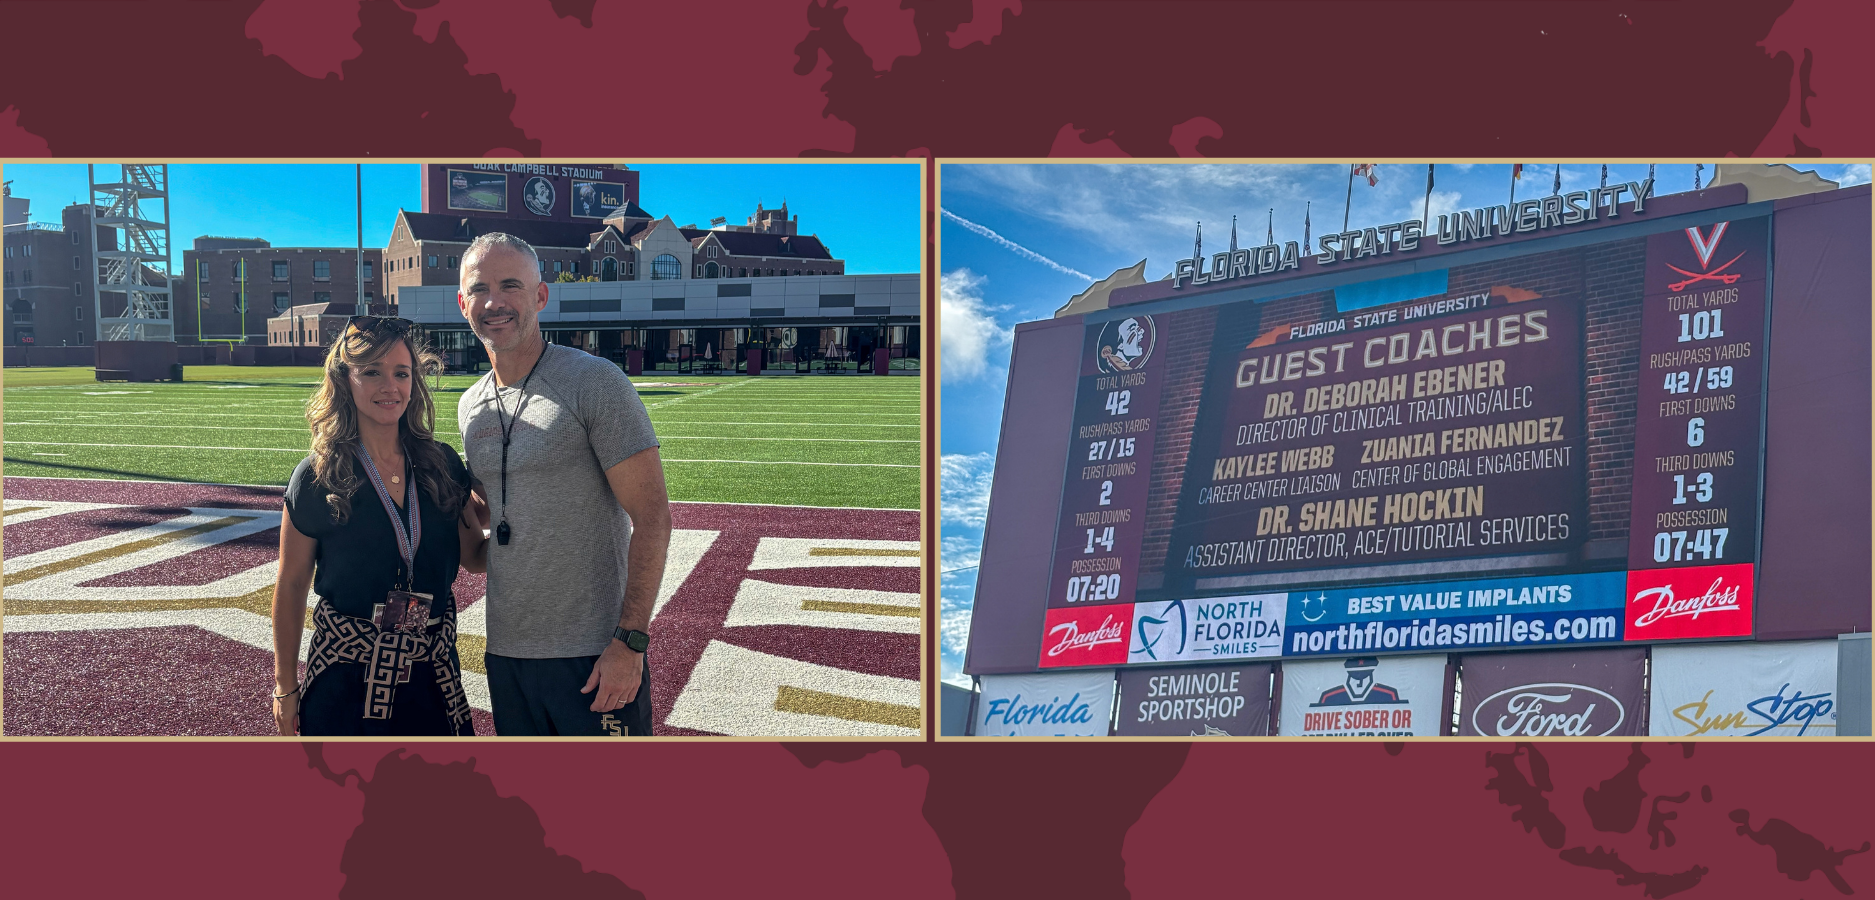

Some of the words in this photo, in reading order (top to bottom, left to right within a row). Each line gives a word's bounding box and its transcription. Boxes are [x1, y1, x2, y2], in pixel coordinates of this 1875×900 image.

[504, 164, 558, 176] CAMPBELL
[562, 166, 603, 180] STADIUM
[1172, 240, 1300, 288] FLORIDA
[1317, 220, 1422, 265] STATE
[1437, 178, 1655, 245] UNIVERSITY
[1668, 294, 1699, 312] TOTAL
[1703, 288, 1738, 306] YARDS
[1290, 318, 1346, 340] FLORIDA
[1354, 310, 1397, 328] STATE
[1404, 292, 1490, 320] UNIVERSITY
[1678, 308, 1724, 342] 101
[1236, 342, 1354, 388] GUEST
[1364, 310, 1549, 368] COACHES
[1650, 347, 1711, 369] RUSH/PASS
[1714, 342, 1750, 361] YARDS
[1096, 376, 1118, 390] TOTAL
[1121, 372, 1146, 388] YARDS
[1264, 390, 1297, 418] DR.
[1303, 374, 1407, 414] DEBORAH
[1413, 359, 1505, 398] EBENER
[1106, 390, 1130, 416] 42
[1236, 416, 1307, 446] DIRECTOR
[1311, 414, 1330, 436] OF
[1332, 404, 1402, 433] CLINICAL
[1408, 386, 1532, 424] TRAINING/ALEC
[1660, 400, 1692, 417] FIRST
[1694, 394, 1736, 414] DOWNS
[1080, 422, 1123, 438] RUSH/PASS
[1125, 418, 1150, 433] YARDS
[1360, 432, 1435, 464] ZUANIA
[1441, 416, 1564, 454] FERNANDEZ
[1687, 417, 1704, 447] 6
[1082, 465, 1106, 480] FIRST
[1107, 462, 1136, 477] DOWNS
[1212, 452, 1278, 480] KAYLEE
[1280, 444, 1335, 472] WEBB
[1352, 466, 1400, 488] CENTER
[1404, 464, 1420, 484] OF
[1424, 458, 1472, 481] GLOBAL
[1476, 446, 1572, 476] ENGAGEMENT
[1656, 454, 1690, 472] THIRD
[1694, 450, 1734, 470] DOWNS
[1099, 480, 1112, 506] 2
[1198, 484, 1246, 504] CAREER
[1244, 478, 1288, 500] CENTER
[1290, 472, 1341, 495] LIAISON
[1672, 472, 1714, 504] 1-3
[1076, 512, 1100, 526] THIRD
[1101, 508, 1131, 524] DOWNS
[1256, 505, 1292, 536] DR.
[1298, 496, 1378, 532] SHANE
[1383, 486, 1484, 524] HOCKIN
[1656, 508, 1728, 528] POSSESSION
[1084, 526, 1114, 554] 1-4
[1184, 539, 1266, 568] ASSISTANT
[1268, 532, 1348, 562] DIRECTOR,
[1354, 522, 1474, 556] ACE/TUTORIAL
[1480, 514, 1570, 546] SERVICES
[1654, 528, 1728, 562] 07:47
[1072, 557, 1122, 573] POSSESSION
[1066, 574, 1120, 602] 07:20
[1348, 596, 1394, 615] BEST
[1400, 592, 1461, 612] VALUE
[1468, 584, 1572, 608] IMPLANTS
[1633, 576, 1740, 628] Danfoss
[1196, 600, 1262, 621] NORTH
[1048, 614, 1123, 656] Danfoss
[1194, 620, 1281, 642] FLORIDA
[1292, 614, 1616, 652] northfloridasmiles.com
[1212, 642, 1257, 656] SMILES
[1148, 672, 1240, 698] SEMINOLE
[984, 692, 1094, 726] Florida
[1138, 696, 1245, 722] SPORTSHOP
[1304, 712, 1342, 731] DRIVE
[1344, 710, 1389, 729] SOBER
[1392, 710, 1412, 728] OR
[1496, 692, 1596, 736] Ford
